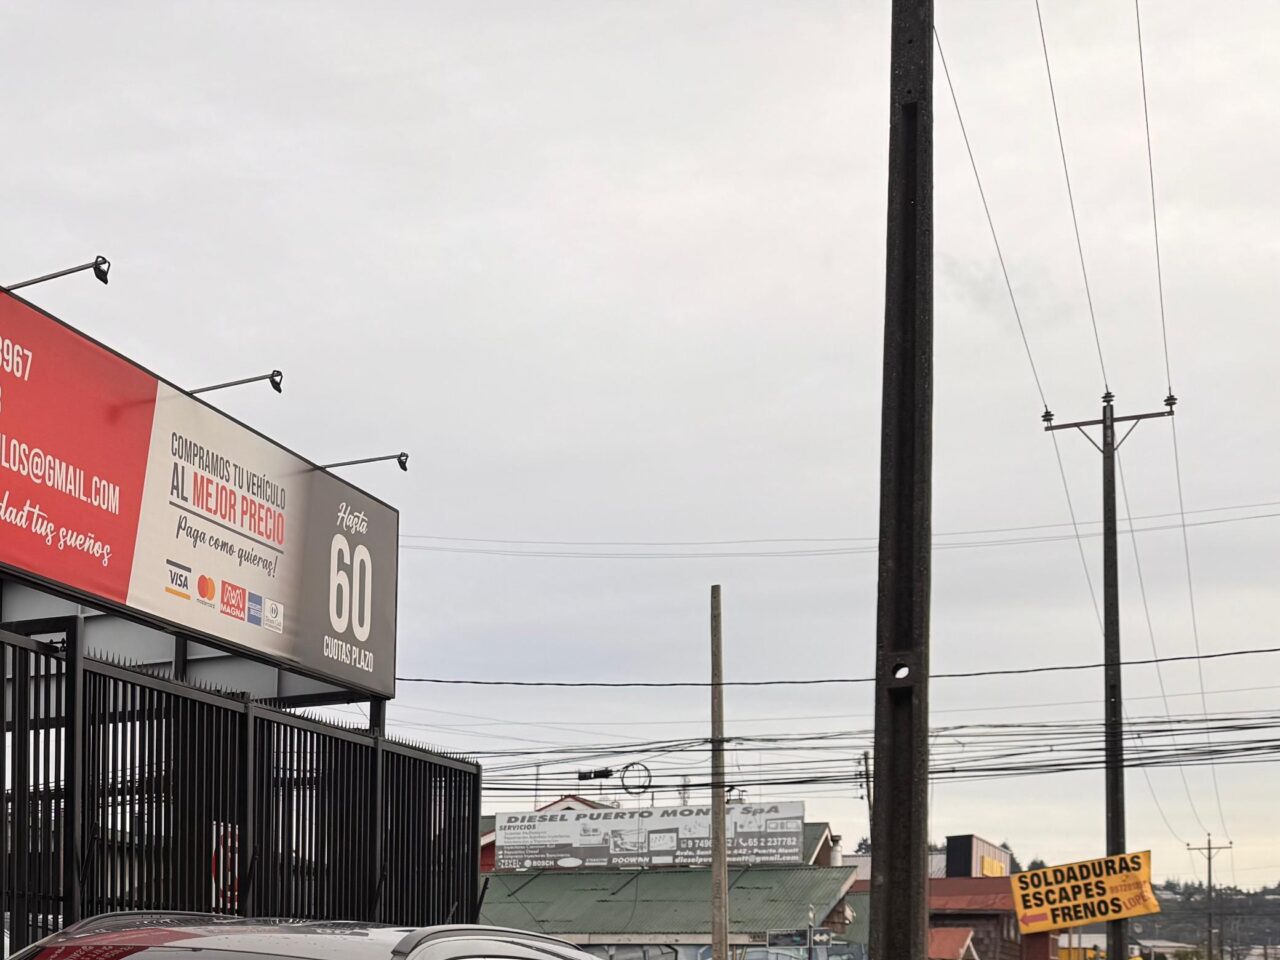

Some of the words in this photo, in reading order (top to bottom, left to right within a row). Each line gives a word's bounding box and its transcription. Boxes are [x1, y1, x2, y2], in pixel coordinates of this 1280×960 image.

[171, 432, 231, 481] COMPRAMOS
[233, 464, 245, 490] TU
[246, 474, 286, 510] VEHÍCULO
[170, 462, 188, 503] AL
[192, 471, 237, 522] MEJOR
[241, 494, 285, 545] PRECIO
[336, 502, 369, 534] Hasta
[27, 501, 56, 545] tus
[58, 524, 112, 567] sueños
[176, 514, 206, 548] Paga
[209, 533, 237, 556] como
[237, 546, 278, 578] quieras!
[169, 569, 189, 590] VISA
[329, 533, 373, 642] 60
[220, 604, 245, 619] MAGNA
[323, 635, 351, 665] CUOTAS
[352, 646, 374, 673] PLAZO
[506, 814, 568, 824] DIESEL
[575, 810, 654, 821] PUERTO
[659, 806, 735, 818] MONT
[740, 805, 780, 817] SpA
[687, 839, 693, 848] 9
[748, 838, 759, 846] 65
[760, 838, 766, 846] 2
[767, 836, 797, 846] 237782
[1018, 855, 1142, 891] SOLDADURAS
[1021, 880, 1107, 910] ESCAPES
[1051, 897, 1123, 924] FRENOS
